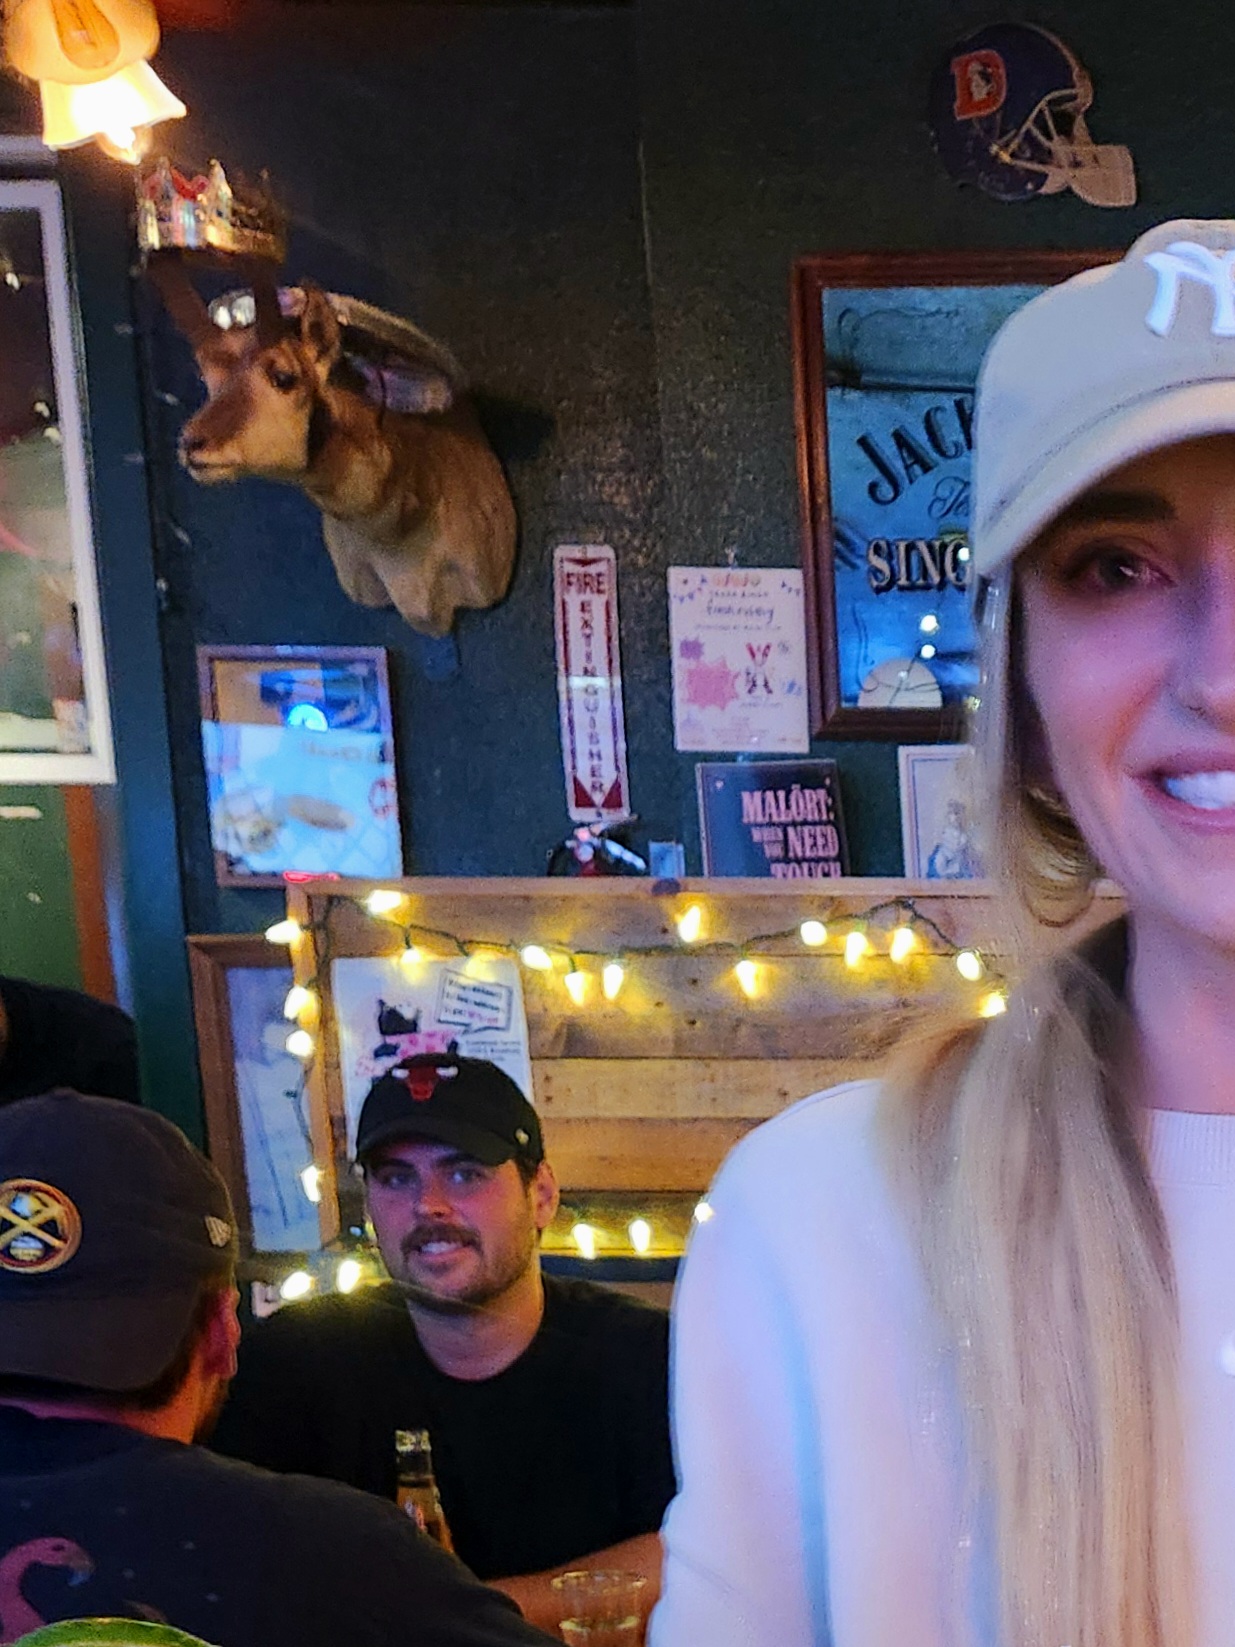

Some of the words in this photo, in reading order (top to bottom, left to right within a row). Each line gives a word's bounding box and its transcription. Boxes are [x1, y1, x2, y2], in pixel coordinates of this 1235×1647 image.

[867, 538, 971, 593] SING
[566, 573, 606, 594] FIRE
[787, 825, 839, 859] NEED
